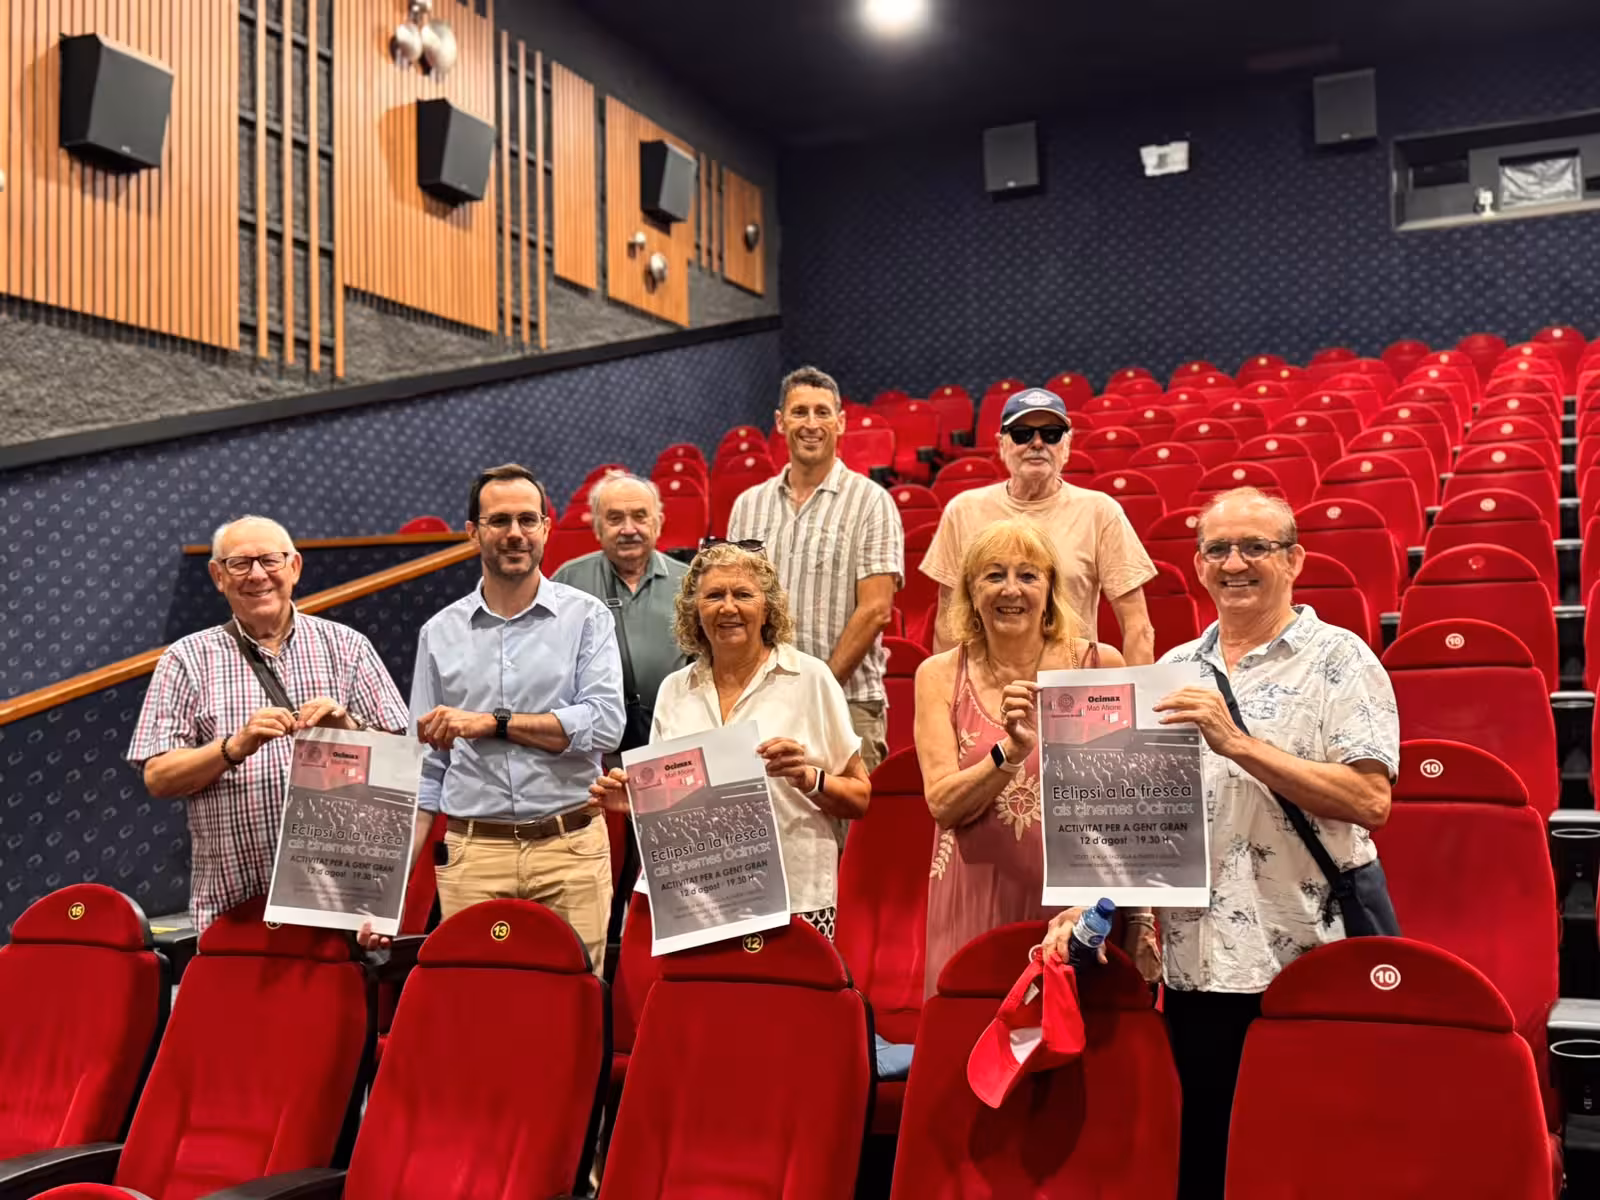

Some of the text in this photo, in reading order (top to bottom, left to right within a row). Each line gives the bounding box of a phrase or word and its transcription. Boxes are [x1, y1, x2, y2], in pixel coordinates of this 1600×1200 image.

[1087, 695, 1121, 703] Ocimax
[664, 760, 692, 771] Ocimax
[1424, 763, 1440, 773] 10
[1052, 783, 1193, 801] Eclipsi a la fresca
[1052, 800, 1195, 817] als cinemes Ocimax
[1058, 822, 1189, 833] ACTIVITAT PER A GENT GRAN
[291, 823, 404, 846] Eclipsi a la fresca
[650, 827, 768, 862] Eclipsi a la fresca
[1080, 837, 1091, 845] 12
[1092, 836, 1128, 847] d'agost
[1135, 835, 1160, 845] 19.30
[723, 841, 771, 861] Ocimax
[290, 855, 329, 866] ACTIVITAT
[660, 859, 769, 891] ACTIVITAT PER A GENT GRAN
[680, 889, 690, 898] 12
[494, 925, 507, 937] 13
[745, 936, 761, 949] 12
[1375, 970, 1396, 984] 10
